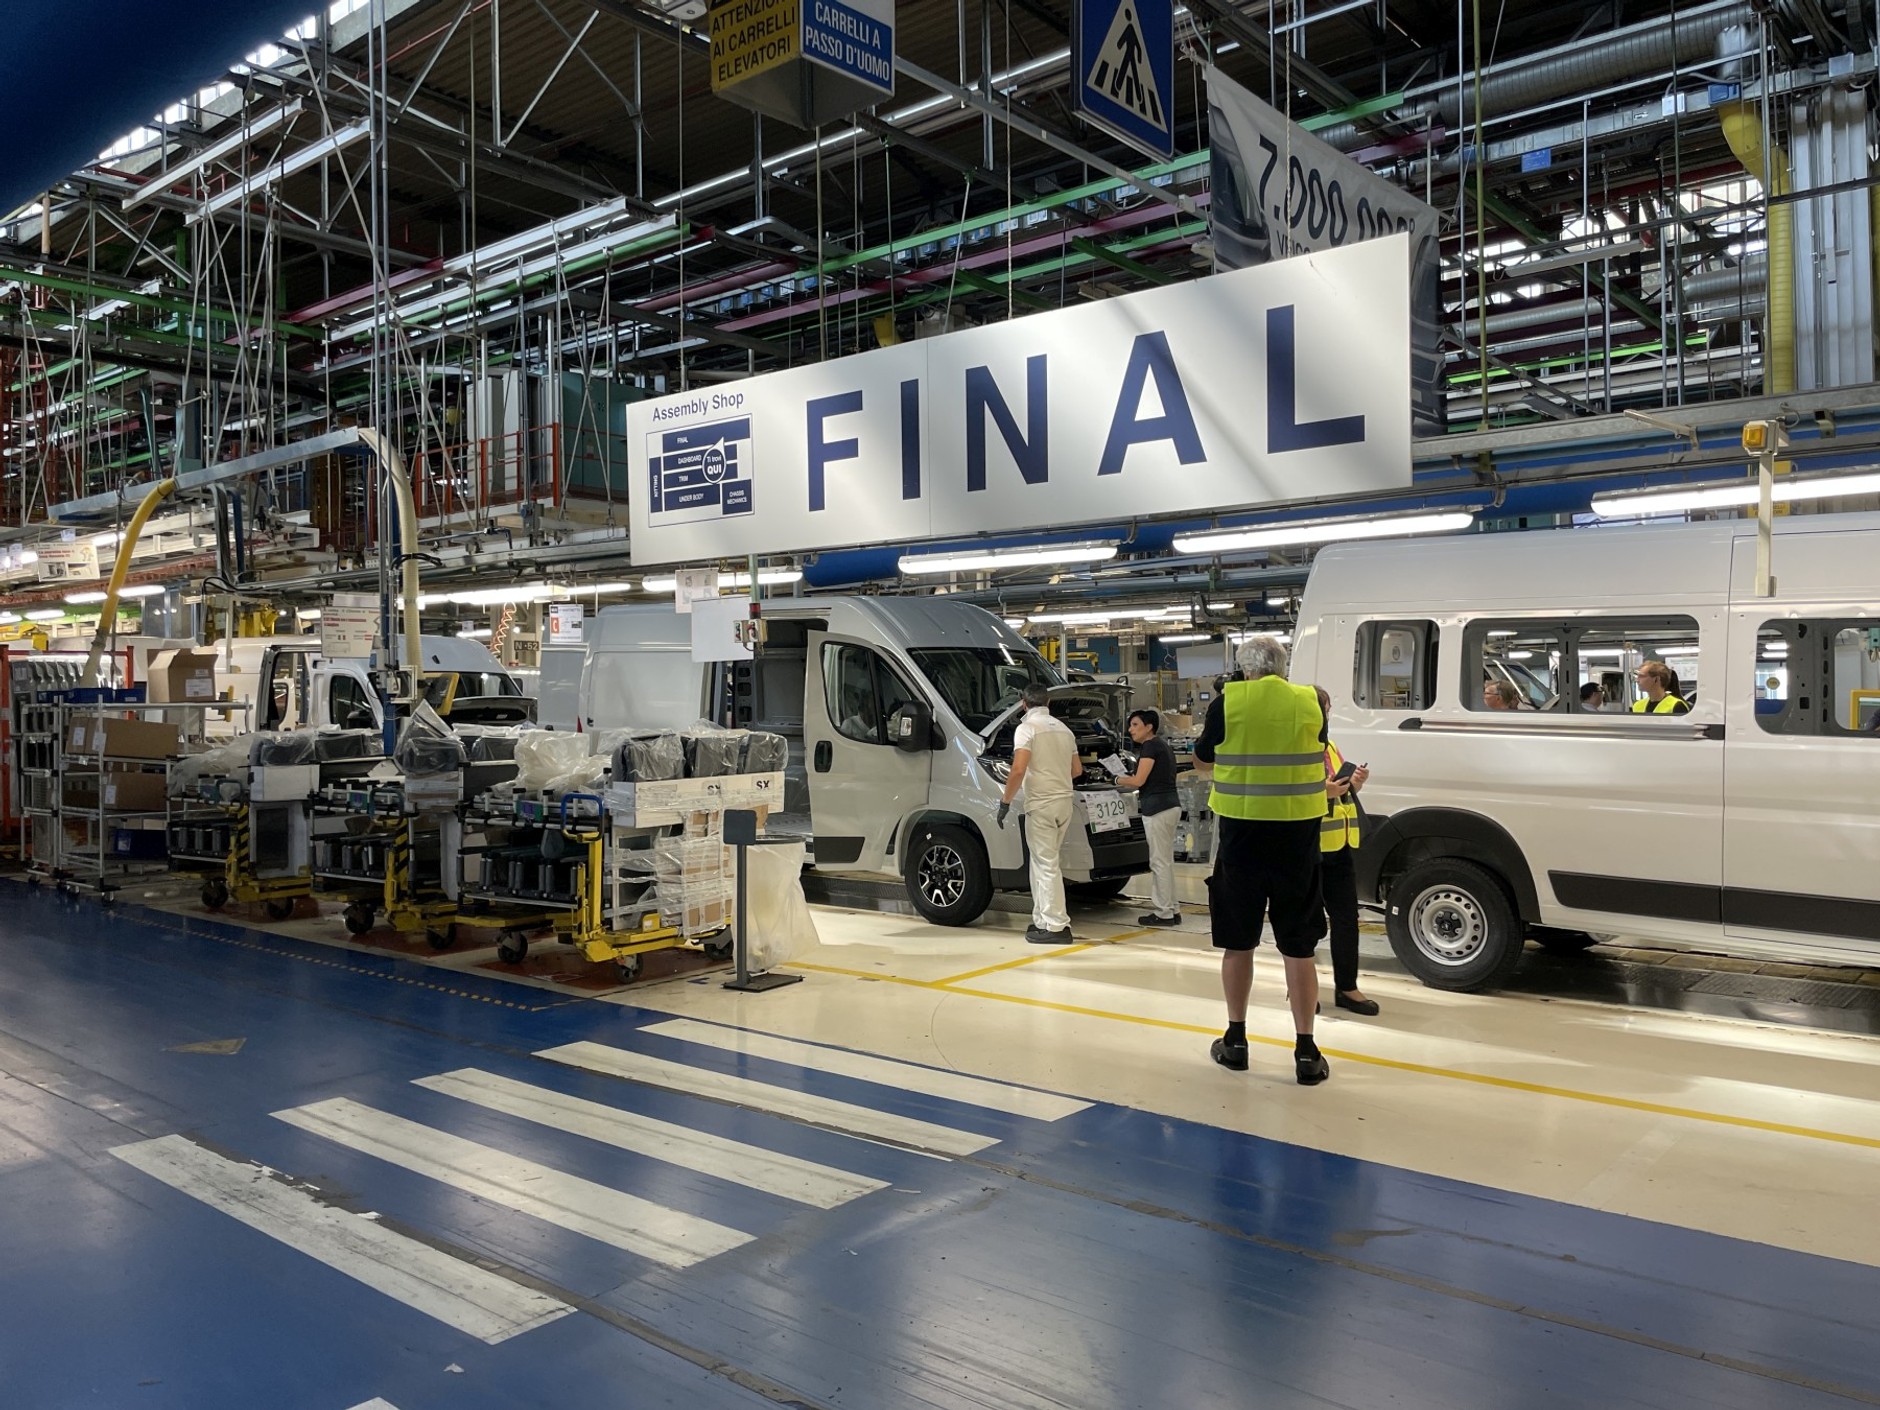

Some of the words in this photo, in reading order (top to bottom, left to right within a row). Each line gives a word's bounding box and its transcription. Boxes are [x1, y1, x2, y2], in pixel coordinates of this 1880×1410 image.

[713, 0, 784, 35] ATTENZIO
[714, 37, 725, 60] AI
[729, 6, 795, 52] CARRELLI
[815, 1, 869, 44] CARRELLI
[872, 28, 881, 50] A
[718, 35, 790, 82] ELEVATORI
[805, 25, 843, 60] PASSO
[846, 44, 890, 81] D'UOMO
[652, 397, 708, 421] Assembly
[712, 393, 744, 410] Shop
[806, 303, 1366, 513] FINAL
[677, 454, 702, 464] DASHBOARD
[707, 464, 722, 475] QUI
[756, 779, 770, 790] SX
[1096, 799, 1125, 819] 3129
